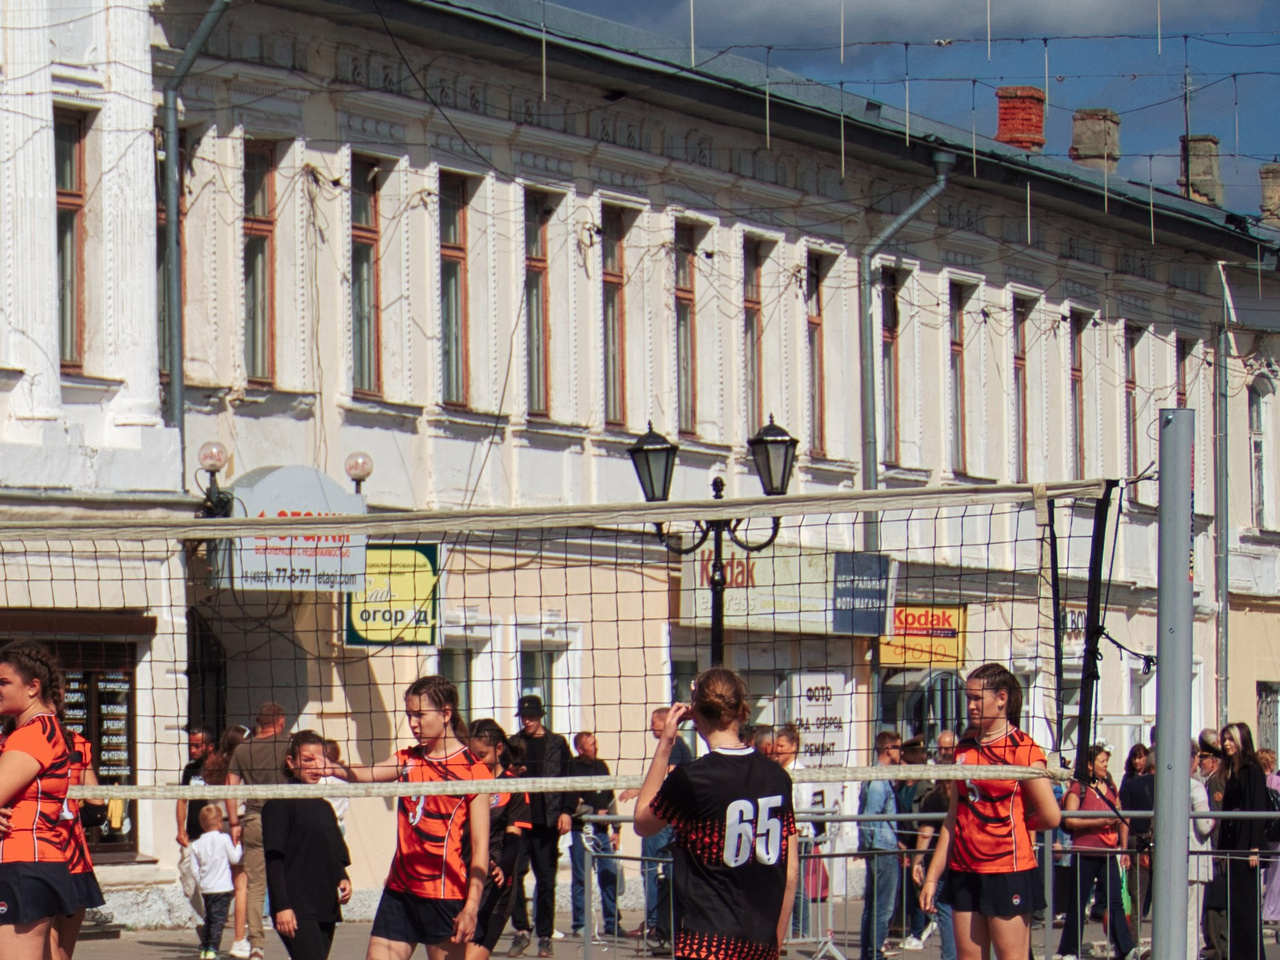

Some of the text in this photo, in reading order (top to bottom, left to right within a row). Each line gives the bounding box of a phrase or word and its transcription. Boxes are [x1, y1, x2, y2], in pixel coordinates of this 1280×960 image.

[275, 567, 311, 584] 77-6-77
[317, 569, 357, 588] etagi.com
[700, 549, 756, 588] Kdak
[701, 594, 757, 612] eress
[360, 609, 428, 626] огорд
[894, 608, 952, 627] Kodak
[806, 686, 833, 702] ФОТО
[723, 795, 782, 868] 65
